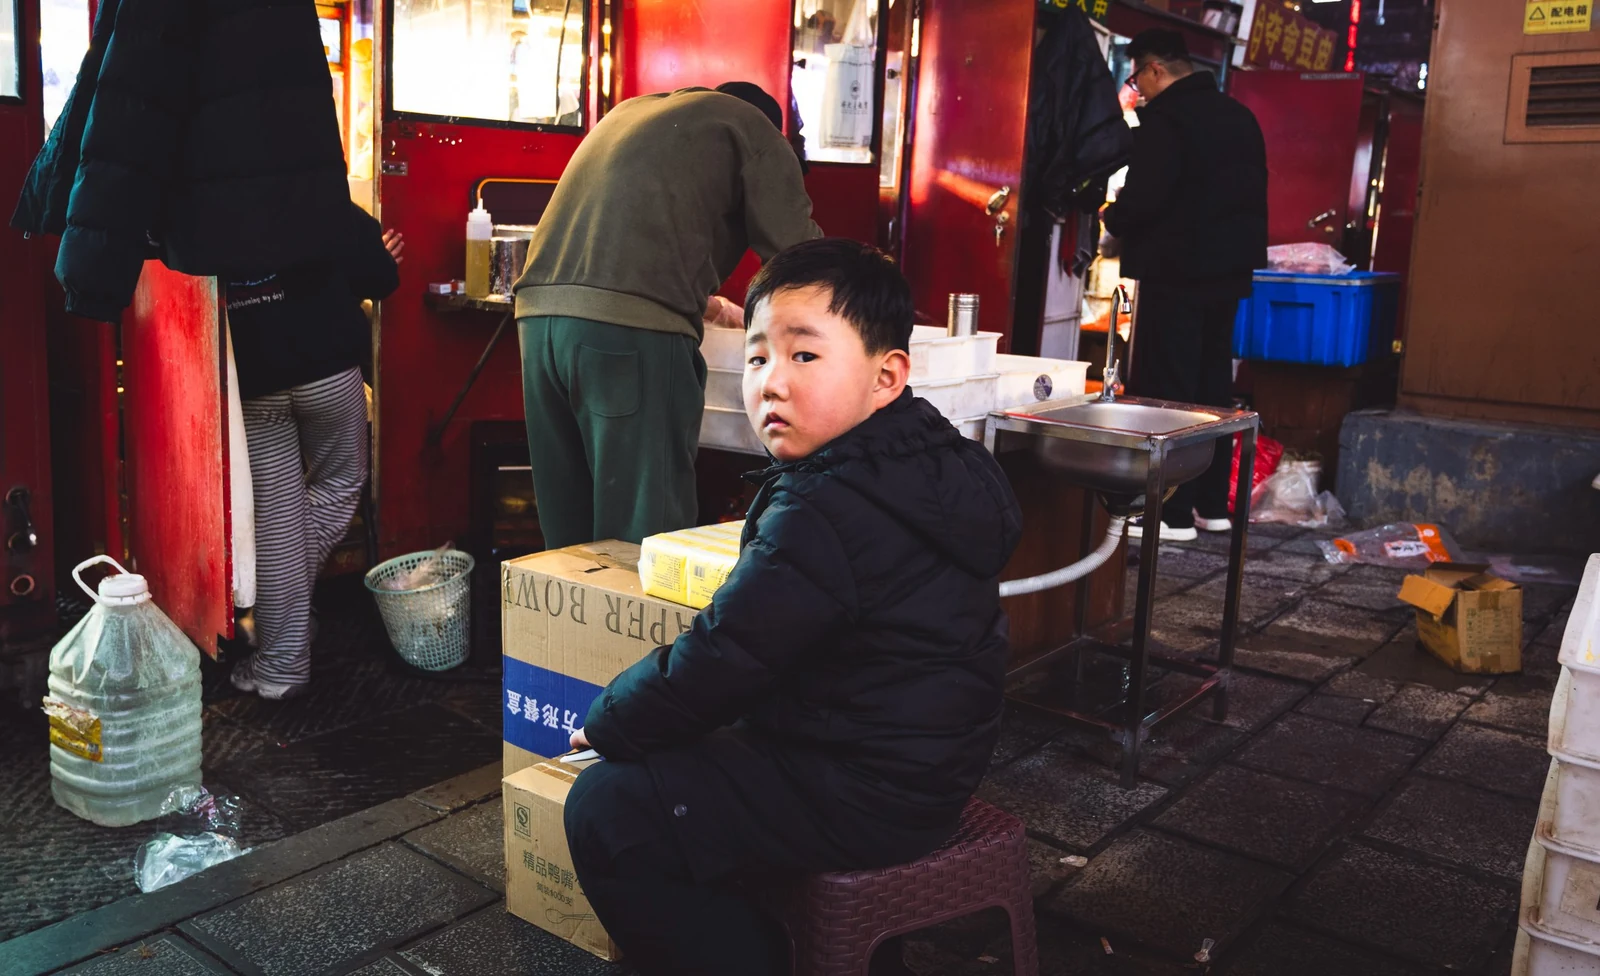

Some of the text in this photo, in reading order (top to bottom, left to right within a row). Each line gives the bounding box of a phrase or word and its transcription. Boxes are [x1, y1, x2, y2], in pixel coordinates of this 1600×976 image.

[1551, 5, 1587, 18] 配电箱
[604, 593, 695, 646] APER
[506, 689, 578, 735] 方形餐盒
